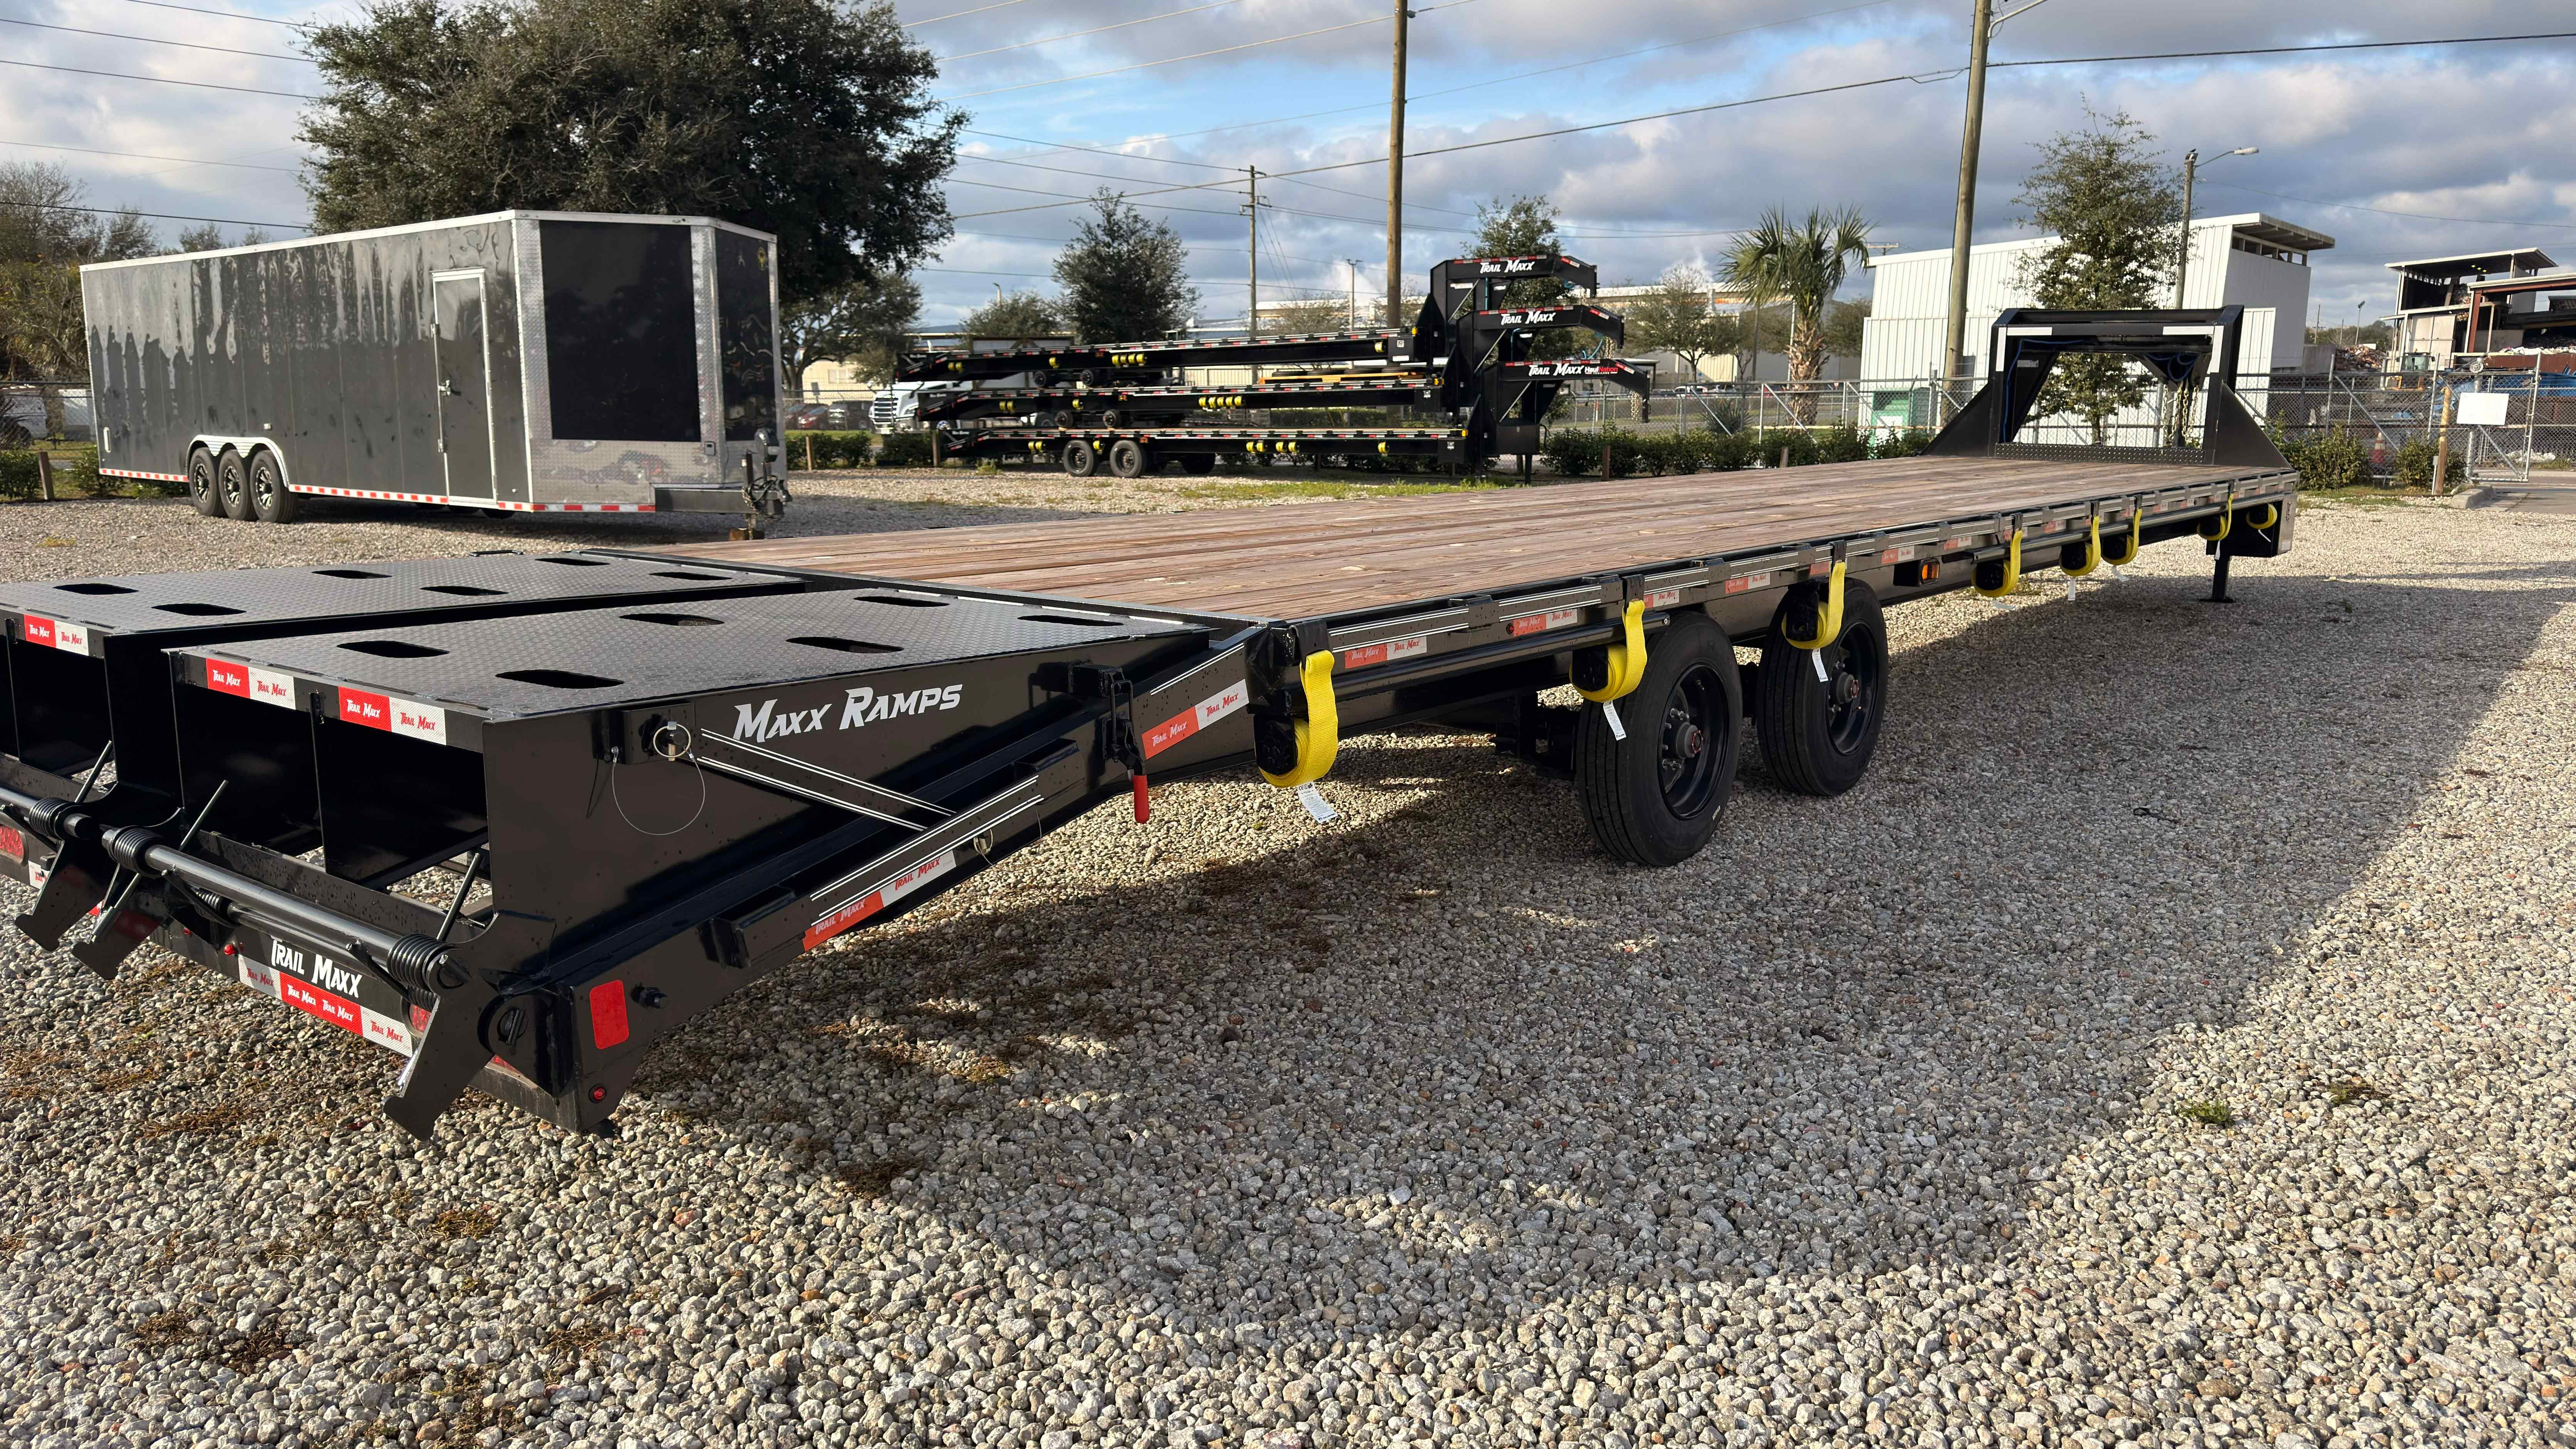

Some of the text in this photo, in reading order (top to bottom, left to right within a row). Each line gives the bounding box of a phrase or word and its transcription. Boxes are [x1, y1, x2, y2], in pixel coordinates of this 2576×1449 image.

[1480, 259, 1535, 273] TRAIL MAXX
[1501, 311, 1556, 325] TRAIL MAXX
[1528, 363, 1585, 376] TRAIL MAXX
[347, 699, 381, 718] TRAIL MAXX
[733, 684, 963, 743] MAXX RAMPS
[1206, 693, 1238, 717] TRAIL MAXX
[400, 712, 436, 731] TRAIL MAXX
[1152, 721, 1187, 747] TRAIL MAXX
[917, 857, 941, 879] MAXX
[840, 899, 866, 921] MAXX
[271, 938, 362, 998] TRAIL MAXX
